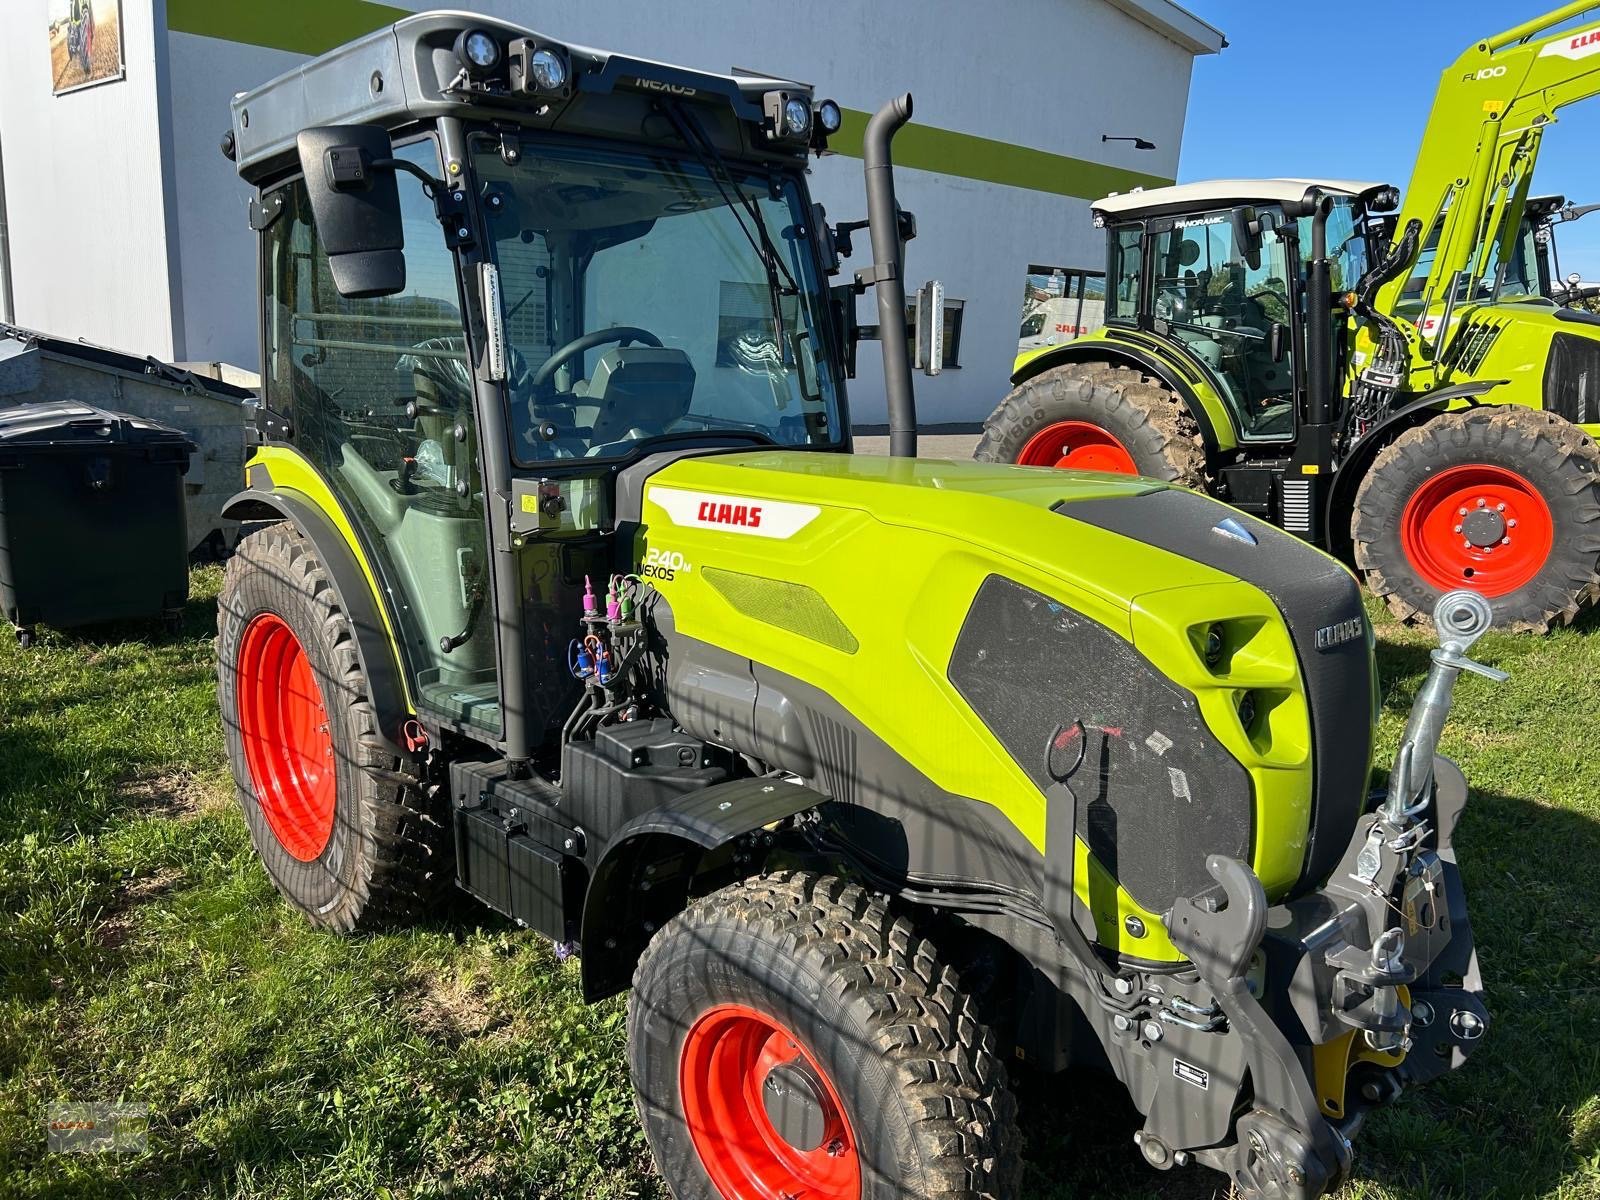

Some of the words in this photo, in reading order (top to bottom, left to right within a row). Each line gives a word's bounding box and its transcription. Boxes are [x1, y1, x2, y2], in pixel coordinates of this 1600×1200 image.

[1174, 216, 1225, 229] PANORAMIC
[697, 501, 763, 528] CLAAS
[636, 562, 675, 582] NEXOS
[1313, 616, 1363, 650] CLAAS
